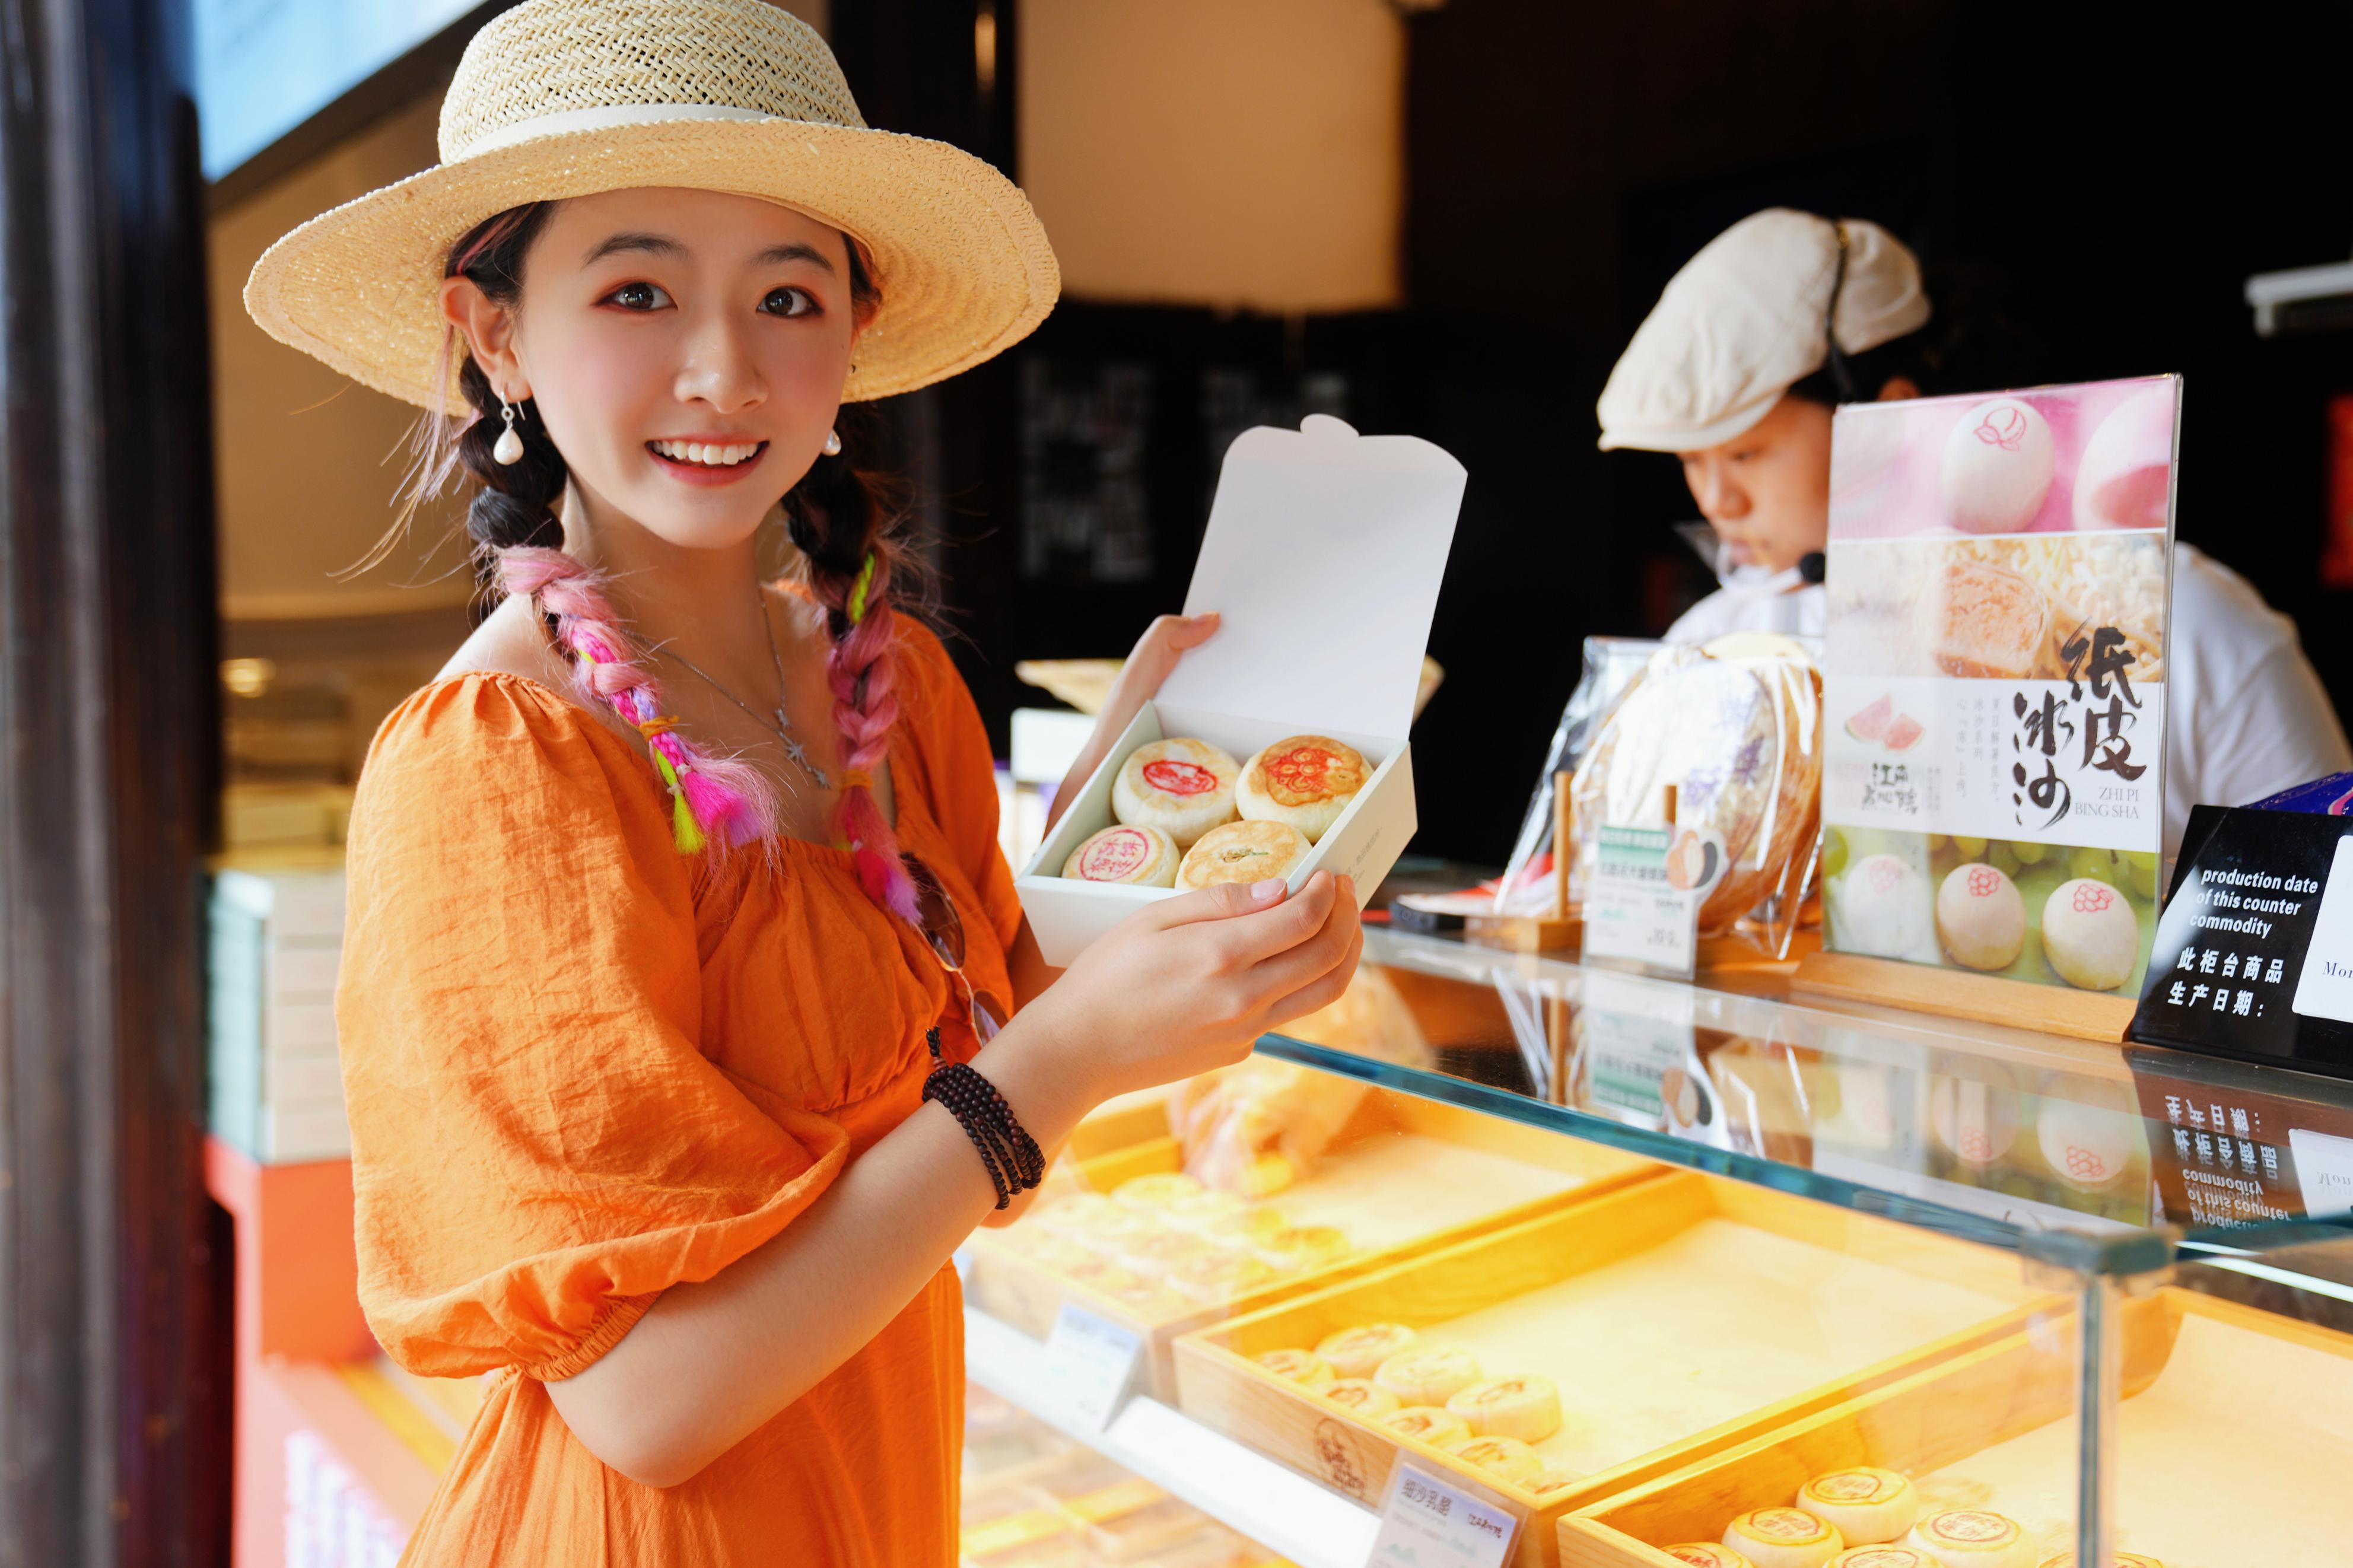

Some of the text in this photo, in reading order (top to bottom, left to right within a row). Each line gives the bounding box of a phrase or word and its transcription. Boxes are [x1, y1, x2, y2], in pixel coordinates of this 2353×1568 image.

[2060, 616, 2147, 781] 纸皮
[2099, 787, 2139, 802] ZHI PI
[2075, 802, 2139, 819] BING SHA
[2201, 868, 2319, 893] production date
[2196, 889, 2302, 915] of this counter
[2190, 915, 2272, 940] commodity
[2177, 946, 2284, 984] 此柜台商品
